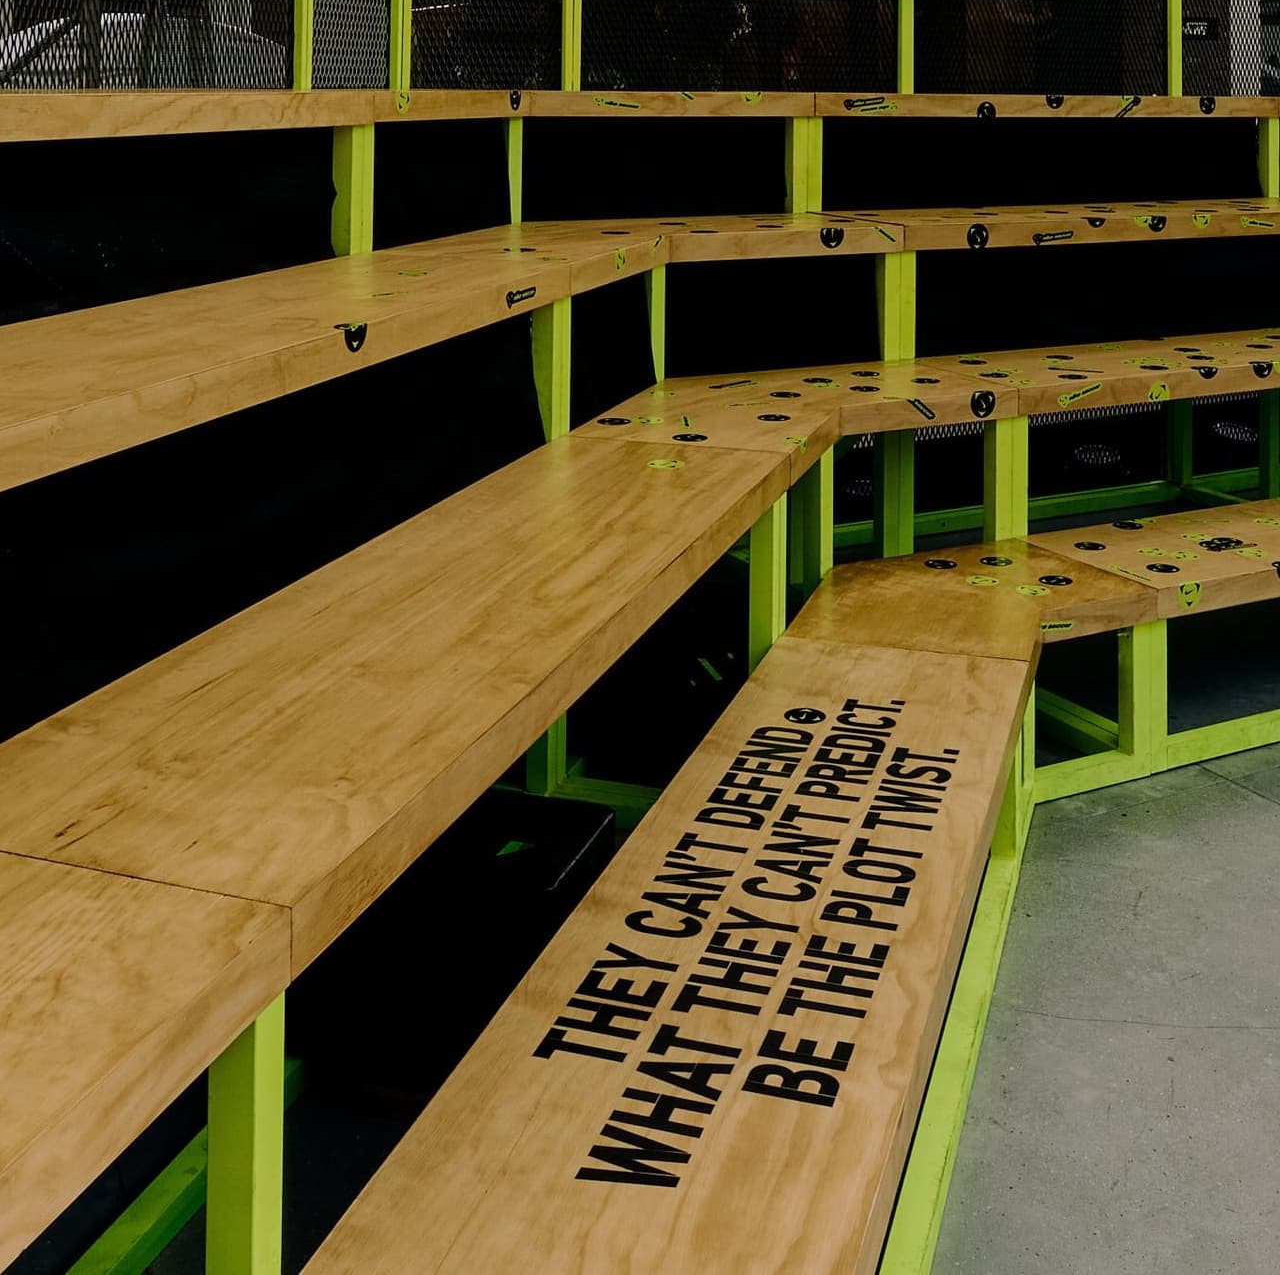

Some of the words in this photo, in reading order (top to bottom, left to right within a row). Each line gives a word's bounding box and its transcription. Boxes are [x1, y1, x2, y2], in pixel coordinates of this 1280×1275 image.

[795, 698, 907, 803] PREDICT.
[861, 747, 960, 832] TWIST.
[532, 943, 680, 1062] THEY
[625, 832, 748, 939] CAN'T
[693, 725, 816, 830] DEFEND
[741, 804, 851, 903] CAN'T
[820, 838, 924, 932] PLOT
[671, 906, 800, 1016] THEY
[777, 934, 891, 1020] THE
[574, 1024, 743, 1188] WHAT
[741, 1028, 856, 1108] BE
